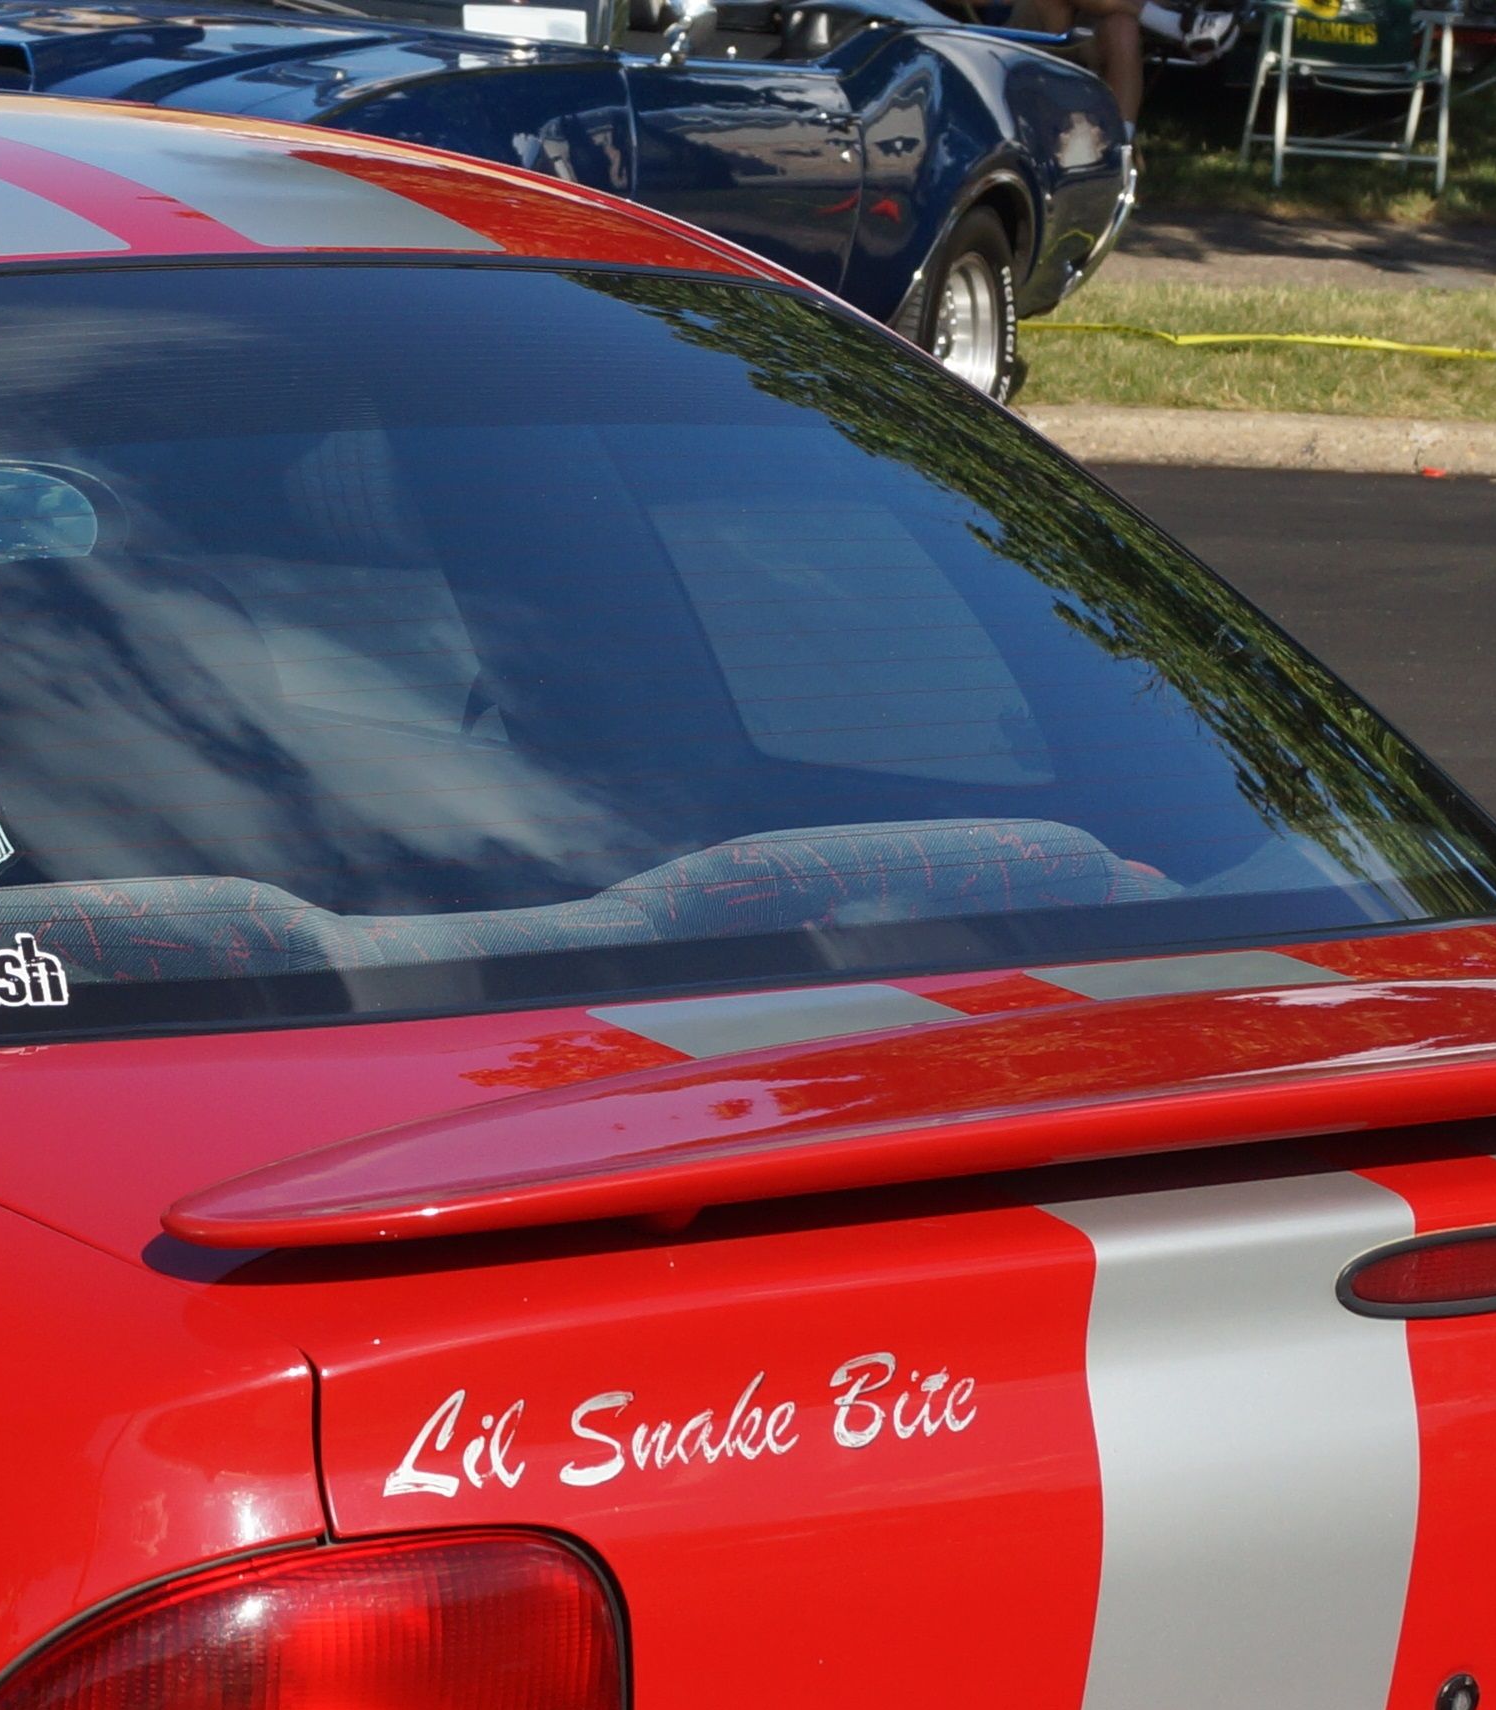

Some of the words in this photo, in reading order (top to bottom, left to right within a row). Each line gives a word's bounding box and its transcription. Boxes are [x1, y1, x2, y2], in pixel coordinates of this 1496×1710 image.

[1296, 18, 1378, 45] PACKERS
[383, 1388, 526, 1498] Lil
[559, 1370, 800, 1487] Snake
[829, 1351, 979, 1450] Bite
